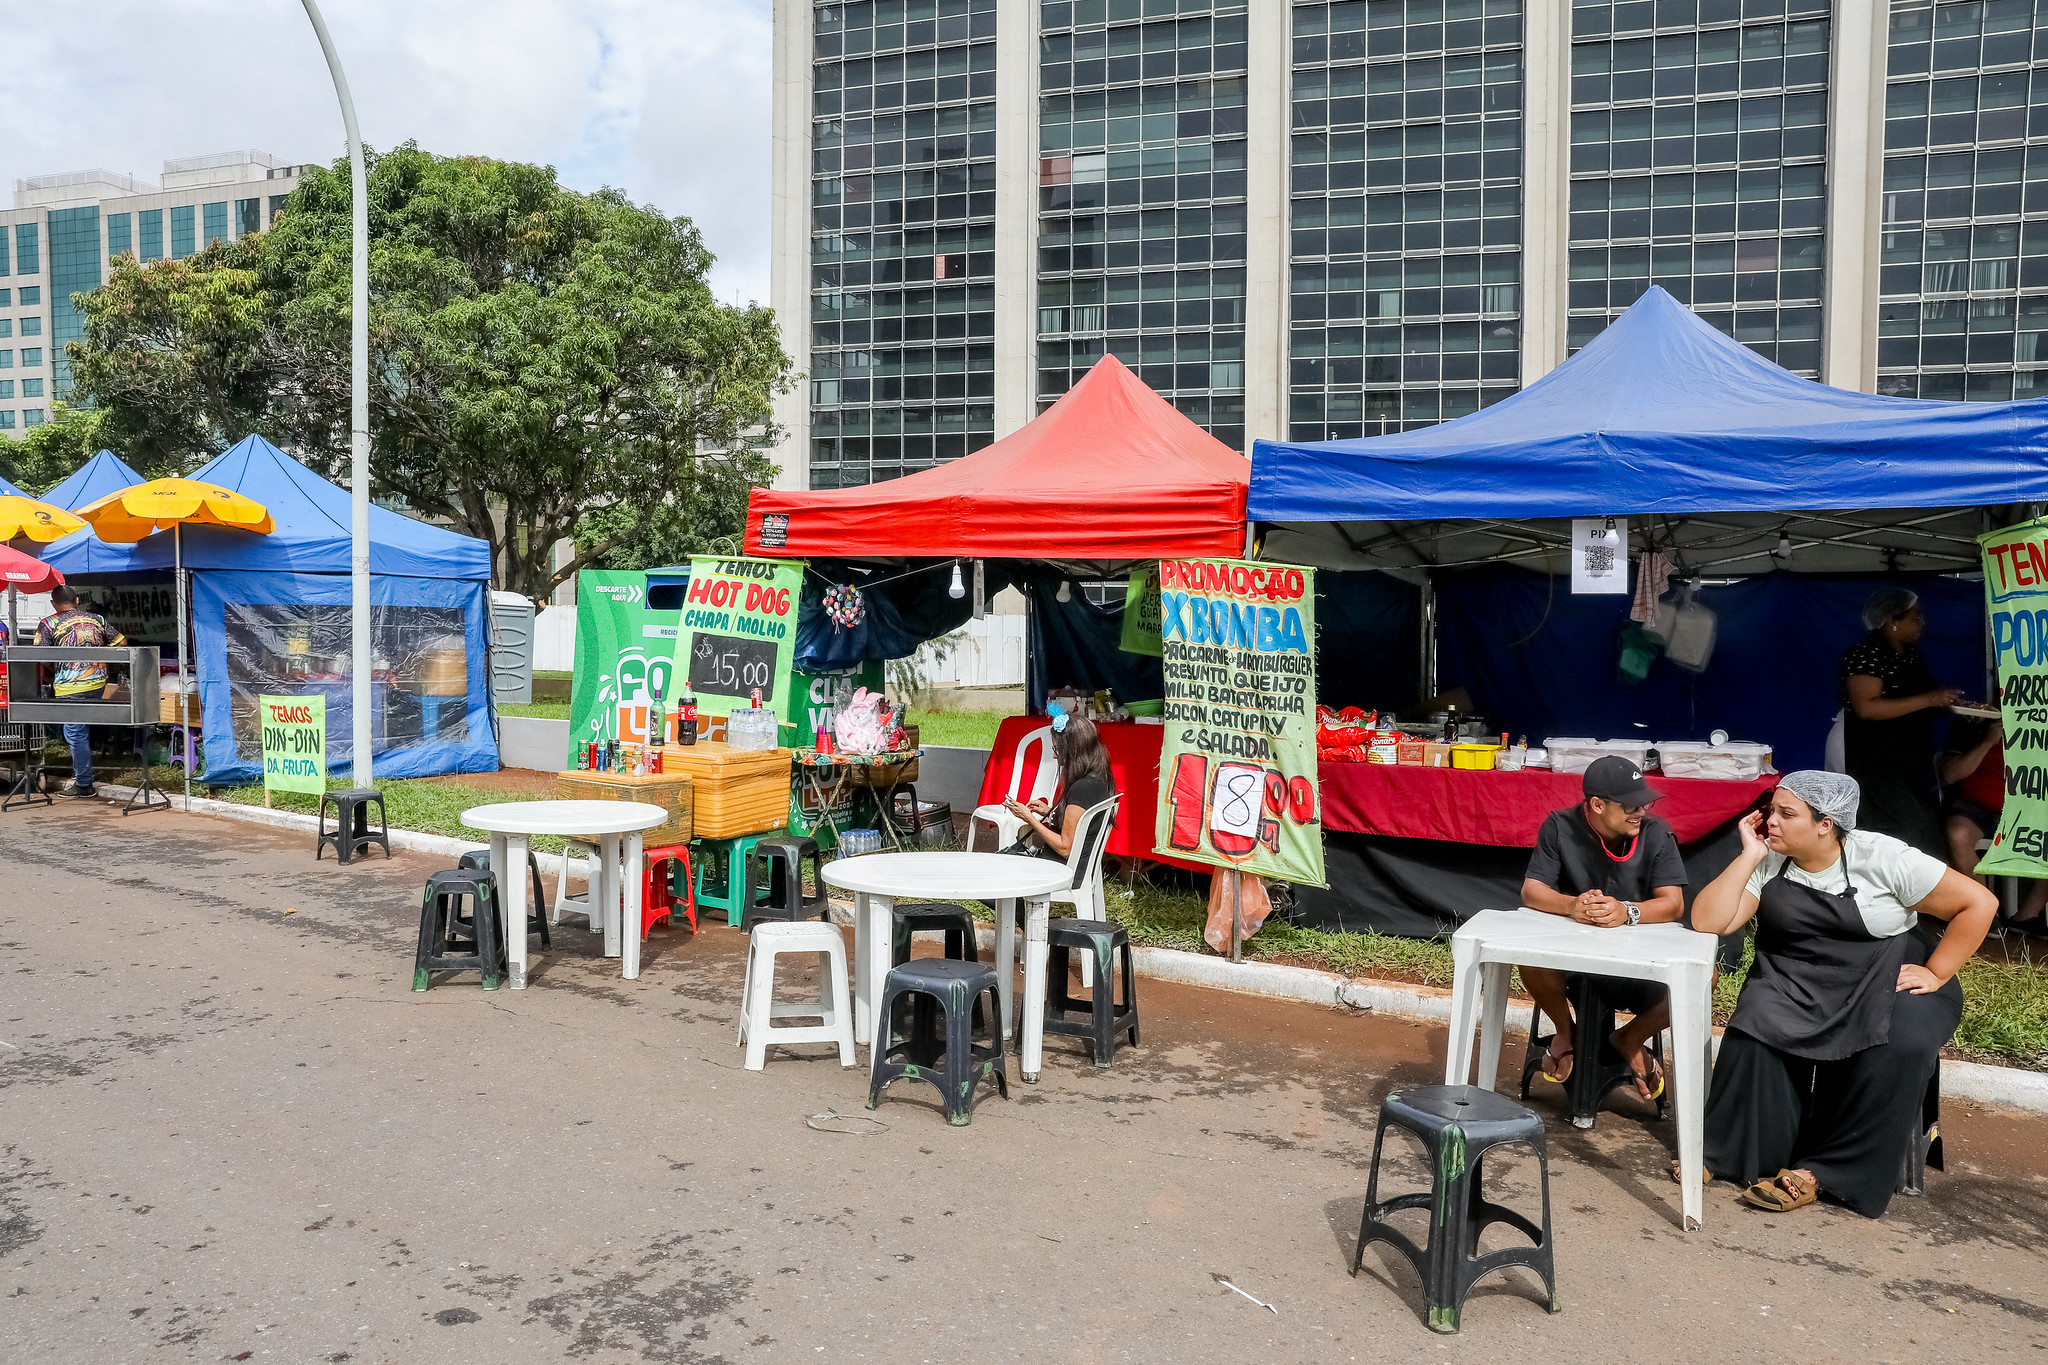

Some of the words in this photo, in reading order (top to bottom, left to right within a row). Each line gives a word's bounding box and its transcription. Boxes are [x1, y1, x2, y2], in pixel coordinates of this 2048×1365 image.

[714, 560, 779, 580] TEMOS
[1161, 561, 1304, 600] PROMOÇÃO
[595, 585, 627, 593] DESCARTE
[611, 594, 627, 602] AQUI
[688, 578, 743, 608] HOT
[745, 583, 791, 616] DOG
[700, 654, 769, 691] 15,00
[1236, 652, 1313, 676] HAMBURGUER
[1165, 681, 1205, 700] MILHO
[1234, 672, 1307, 695] QUEIJO
[269, 705, 313, 724] TEMOS
[1212, 708, 1287, 736] CATUPIRY
[264, 726, 320, 754] DIN-DIN
[267, 757, 279, 773] DA
[282, 758, 318, 777] FRUTA
